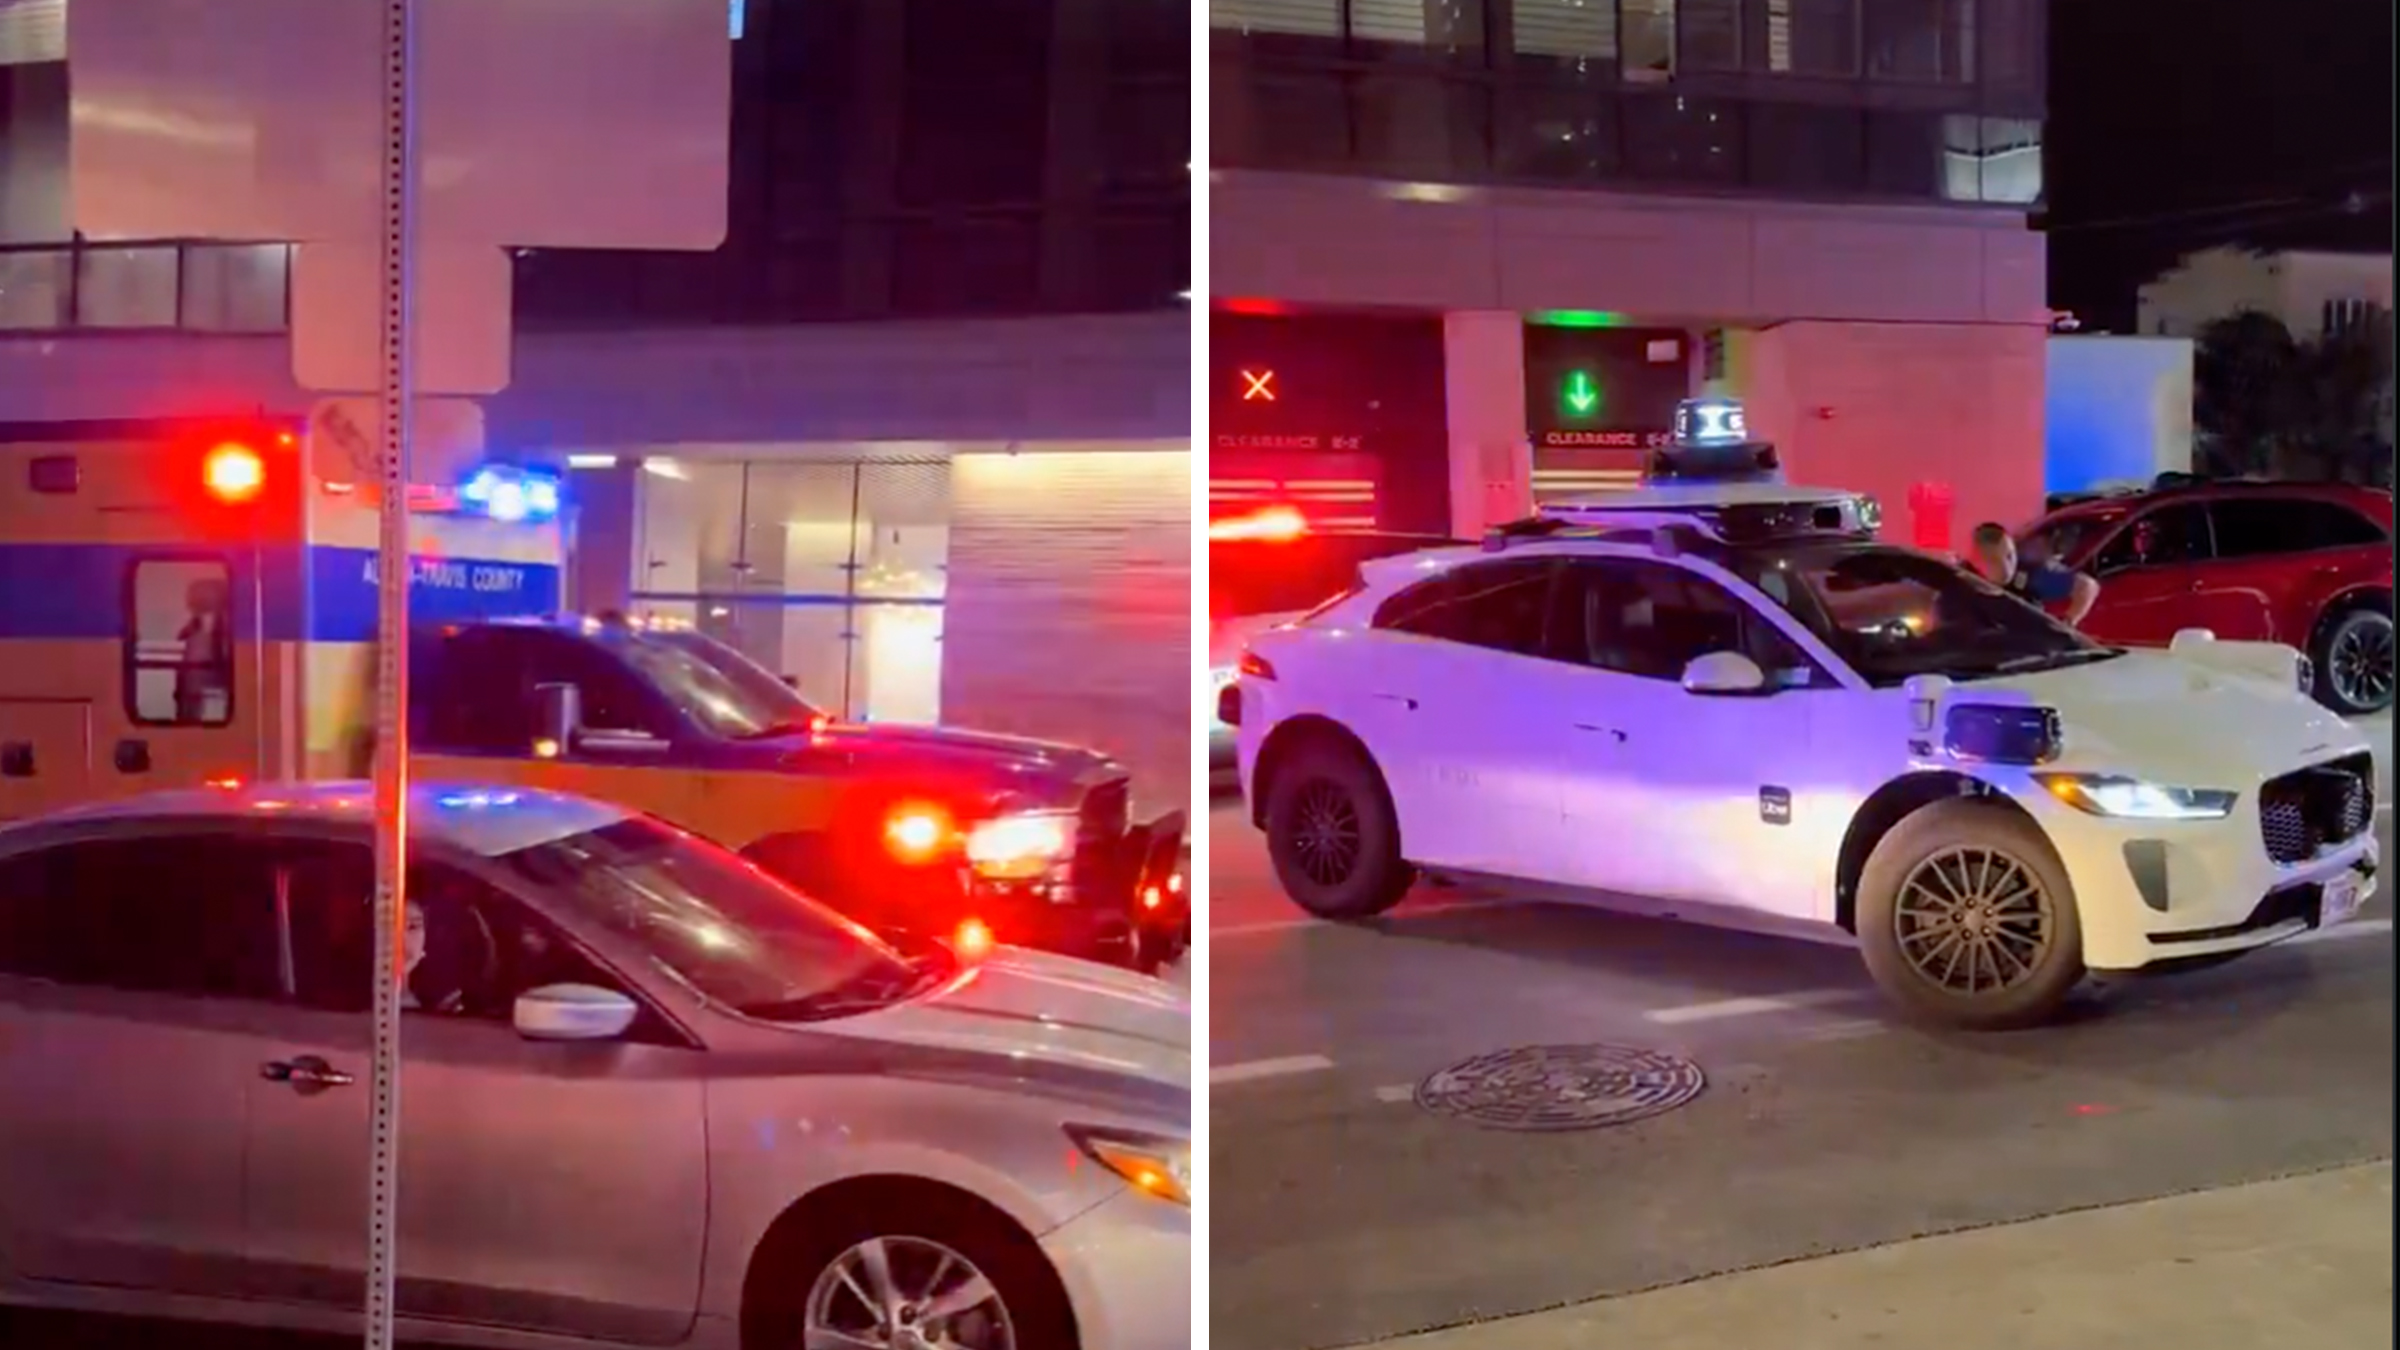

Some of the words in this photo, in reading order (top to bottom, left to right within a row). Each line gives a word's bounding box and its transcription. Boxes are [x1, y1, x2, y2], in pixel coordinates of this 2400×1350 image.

[1217, 434, 1319, 449] CLEARANCE
[1546, 432, 1637, 446] CLEARANCE
[473, 566, 525, 592] COUNTY
